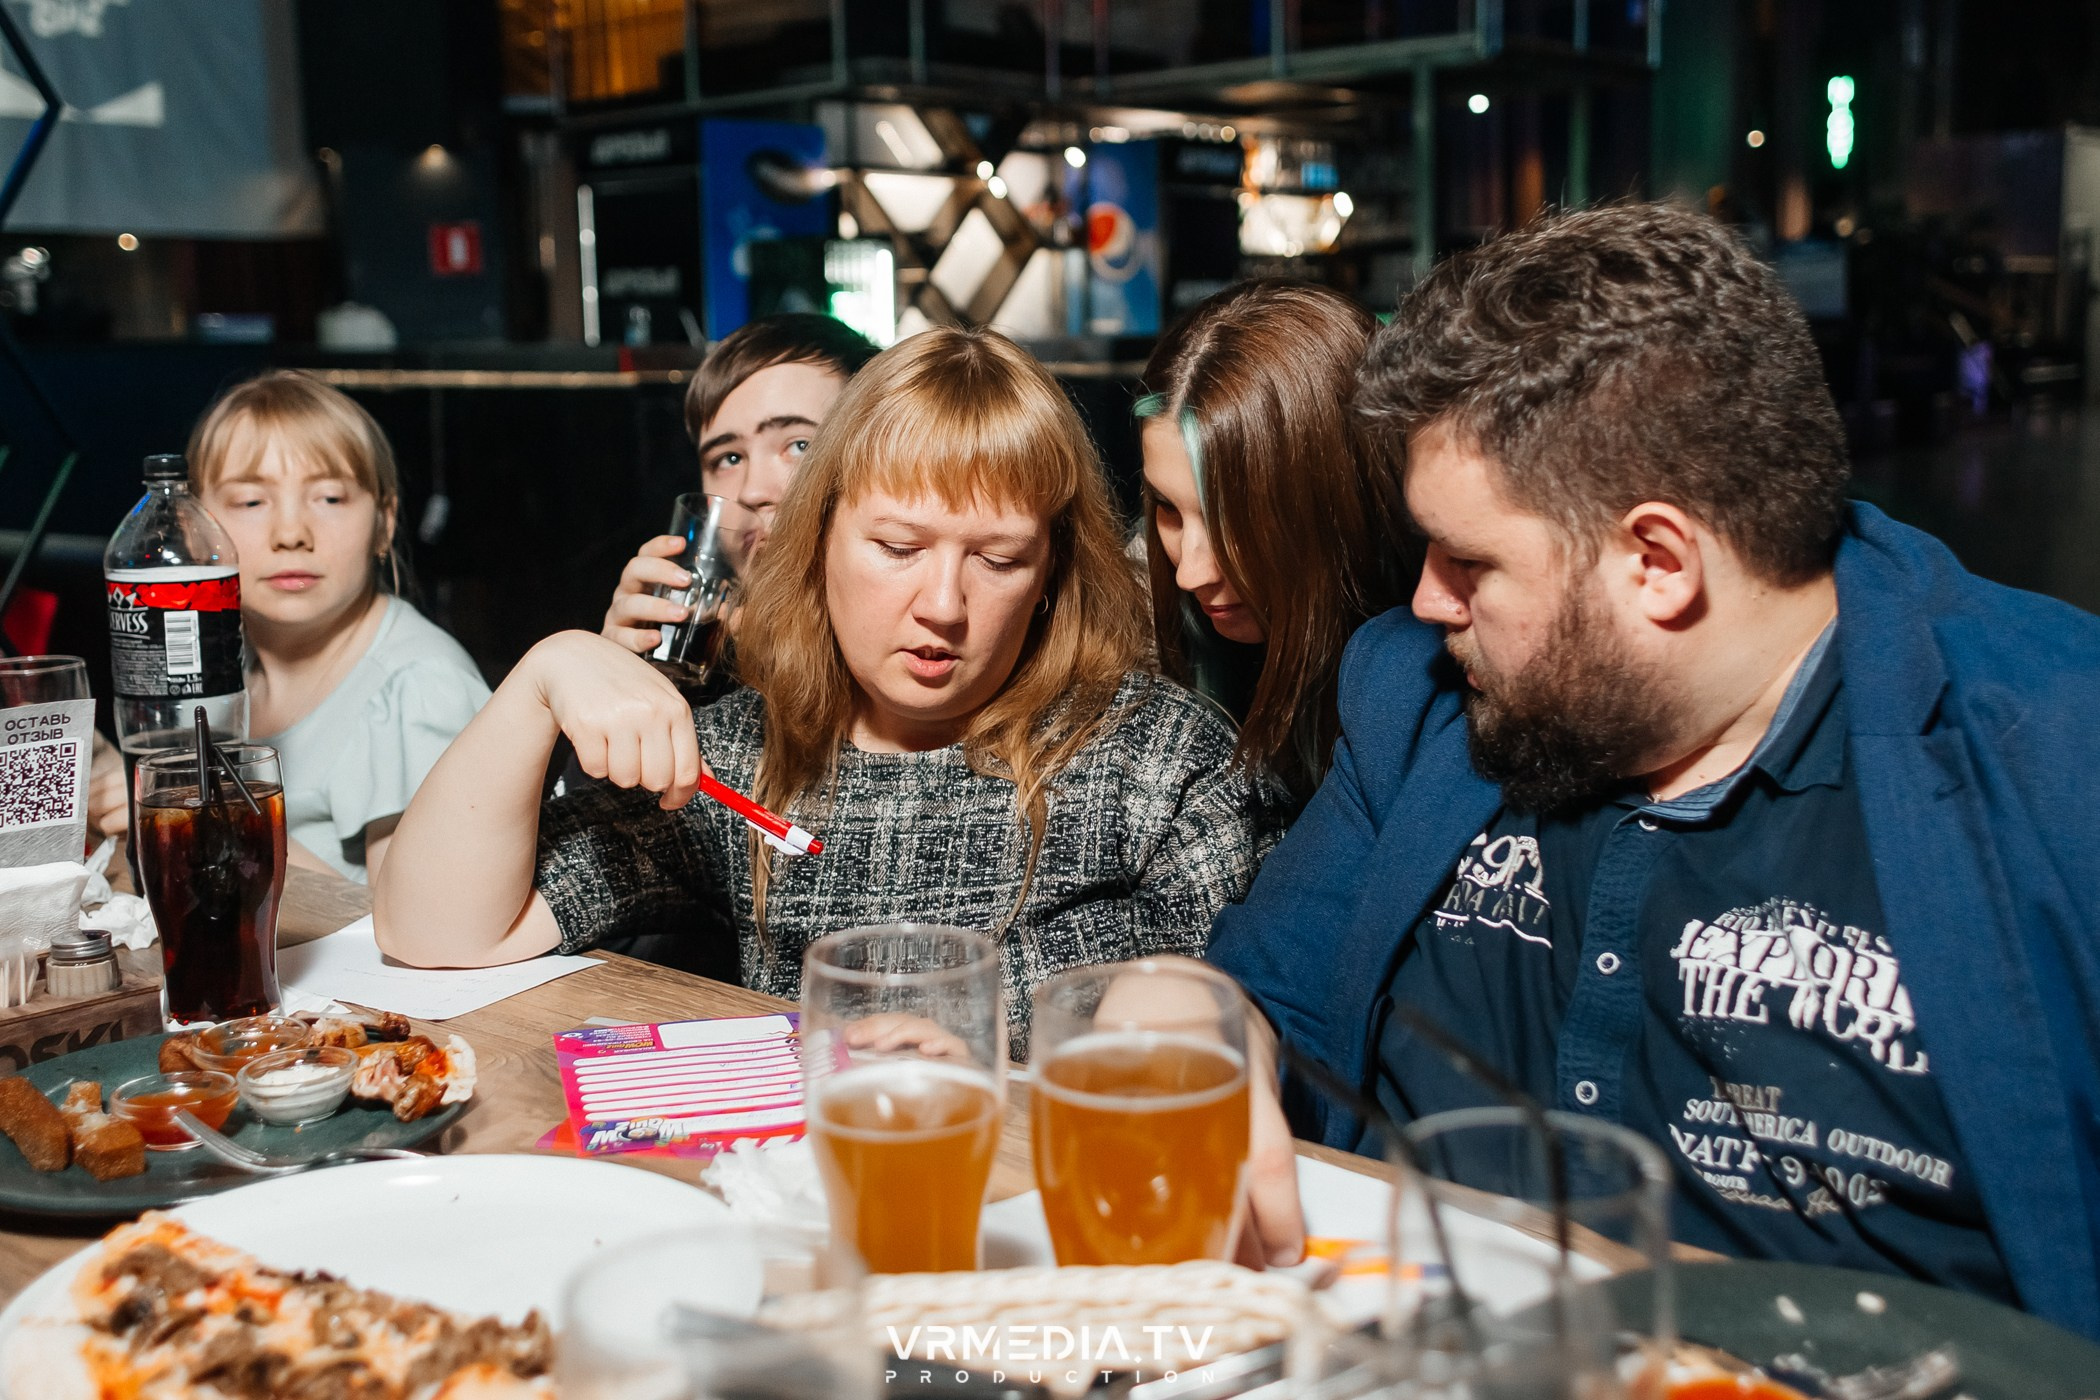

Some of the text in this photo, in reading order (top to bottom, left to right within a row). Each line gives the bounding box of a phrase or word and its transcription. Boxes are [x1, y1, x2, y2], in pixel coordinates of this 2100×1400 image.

[5, 713, 71, 731] ОСТАВЬ
[7, 728, 63, 745] ОТЗЫВ
[1678, 958, 1769, 1024] THE
